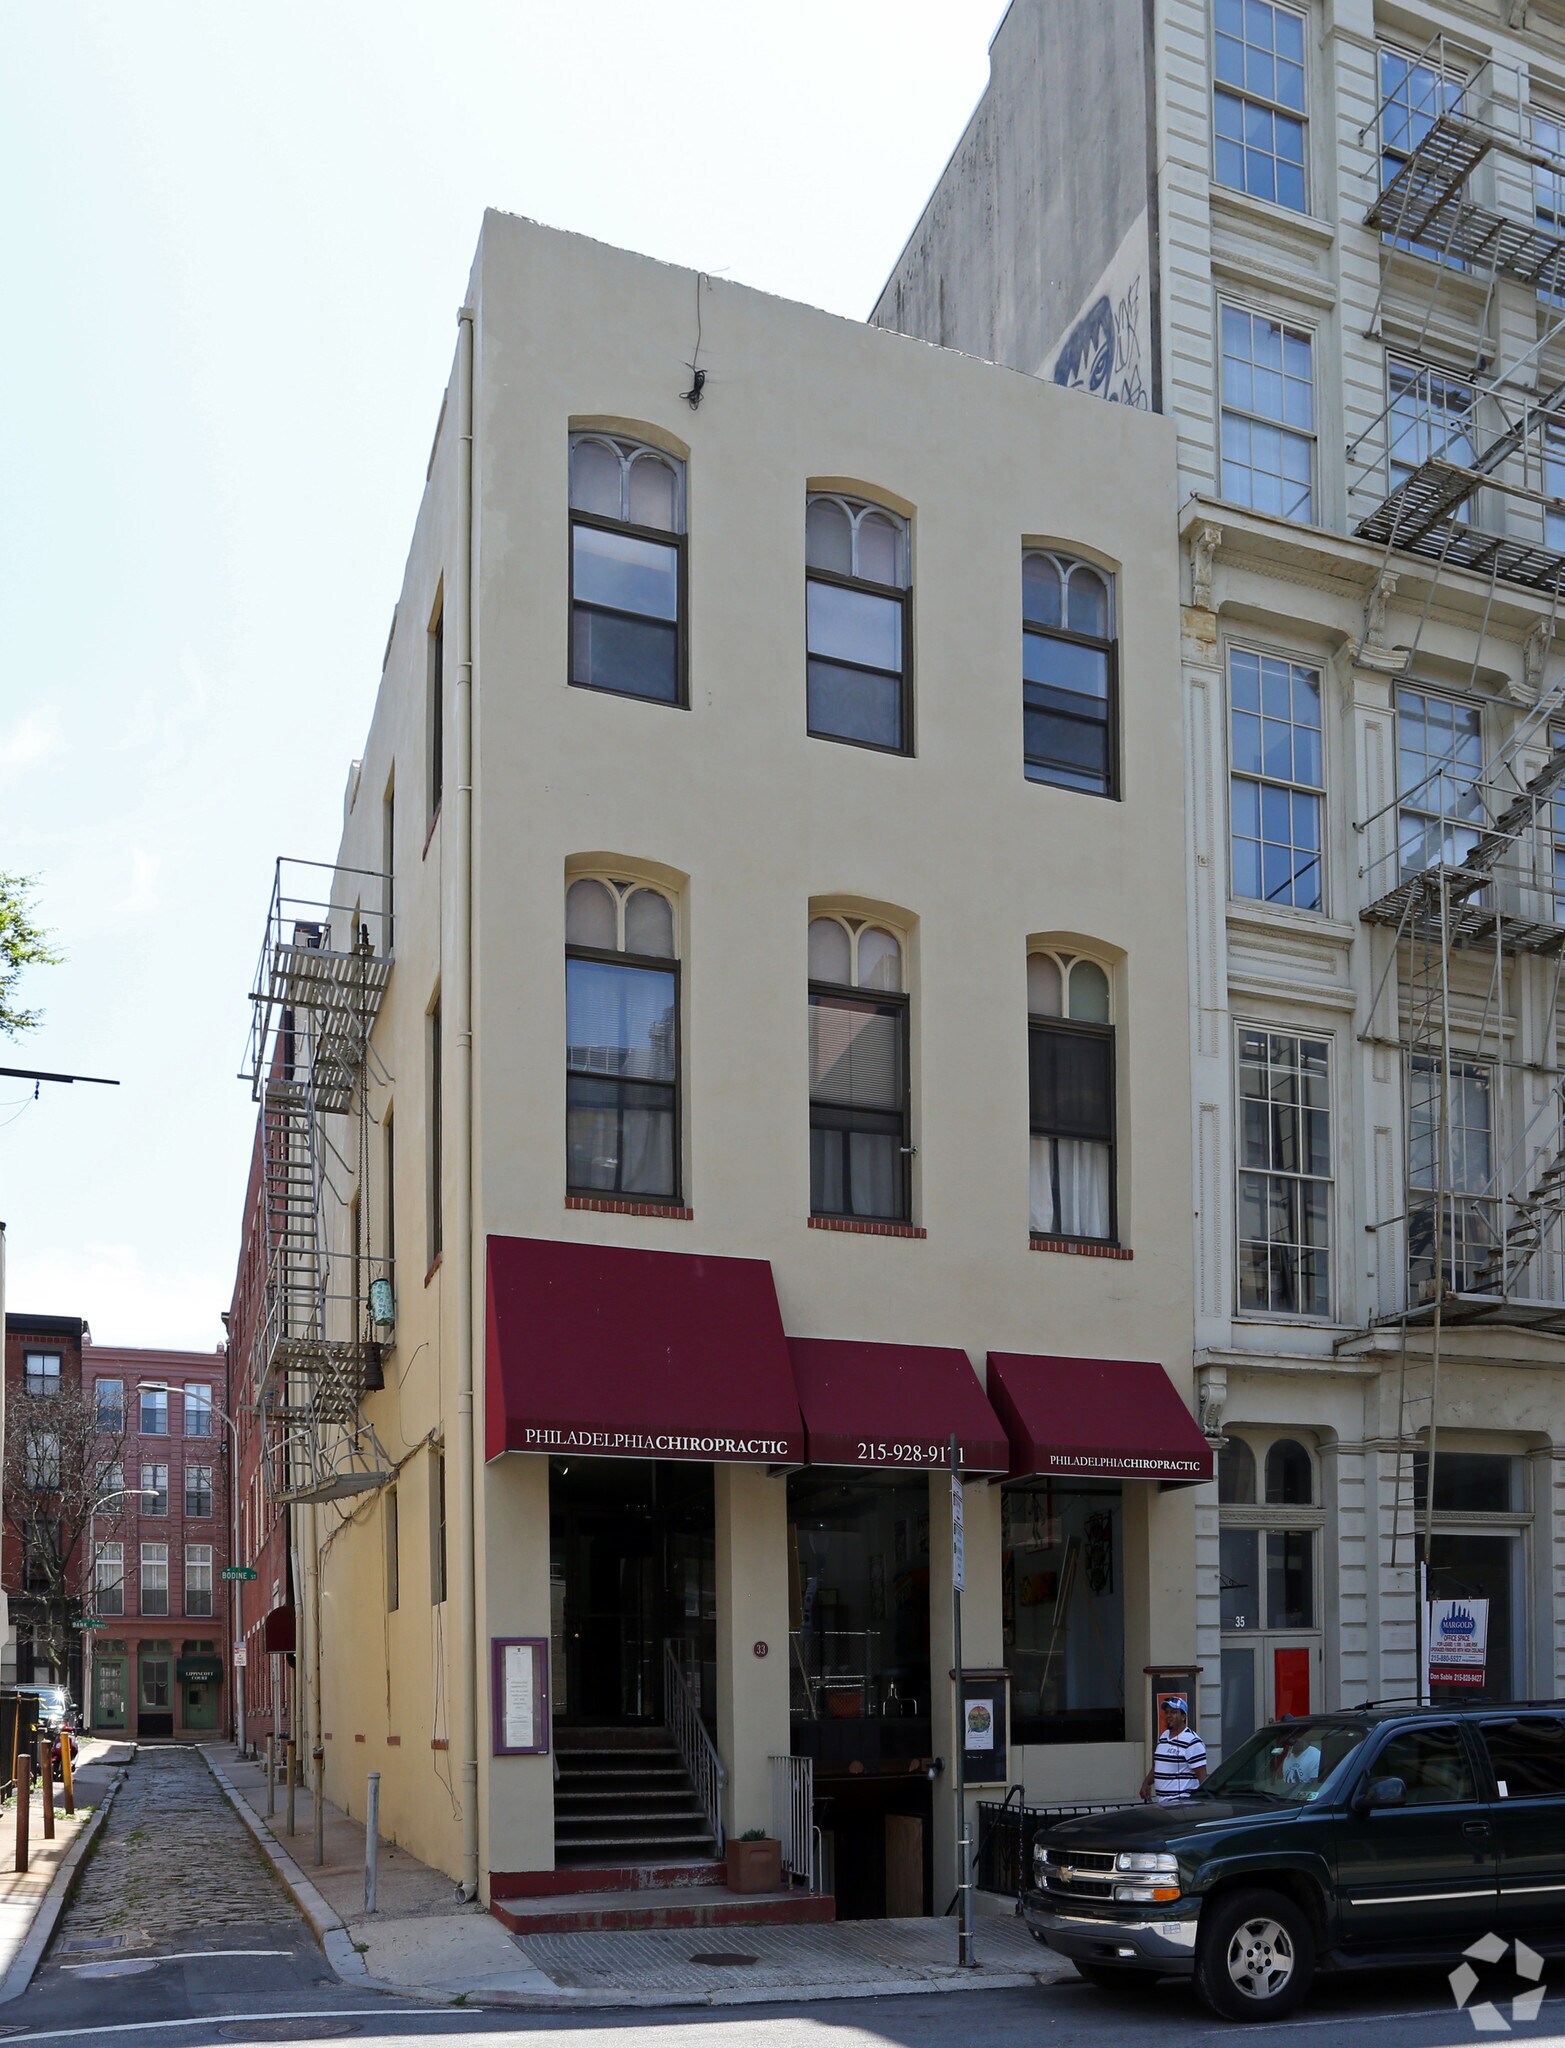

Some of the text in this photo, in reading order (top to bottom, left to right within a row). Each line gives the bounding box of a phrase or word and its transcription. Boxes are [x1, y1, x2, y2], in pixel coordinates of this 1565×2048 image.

[525, 1428, 788, 1455] PHILADELPHIACHIROPRACTIC
[1050, 1455, 1200, 1471] PHILADELPHIACHIROPRACTIC
[1235, 1616, 1245, 1628] 35
[1443, 1621, 1473, 1629] MARGOLIS
[756, 1644, 766, 1655] 33
